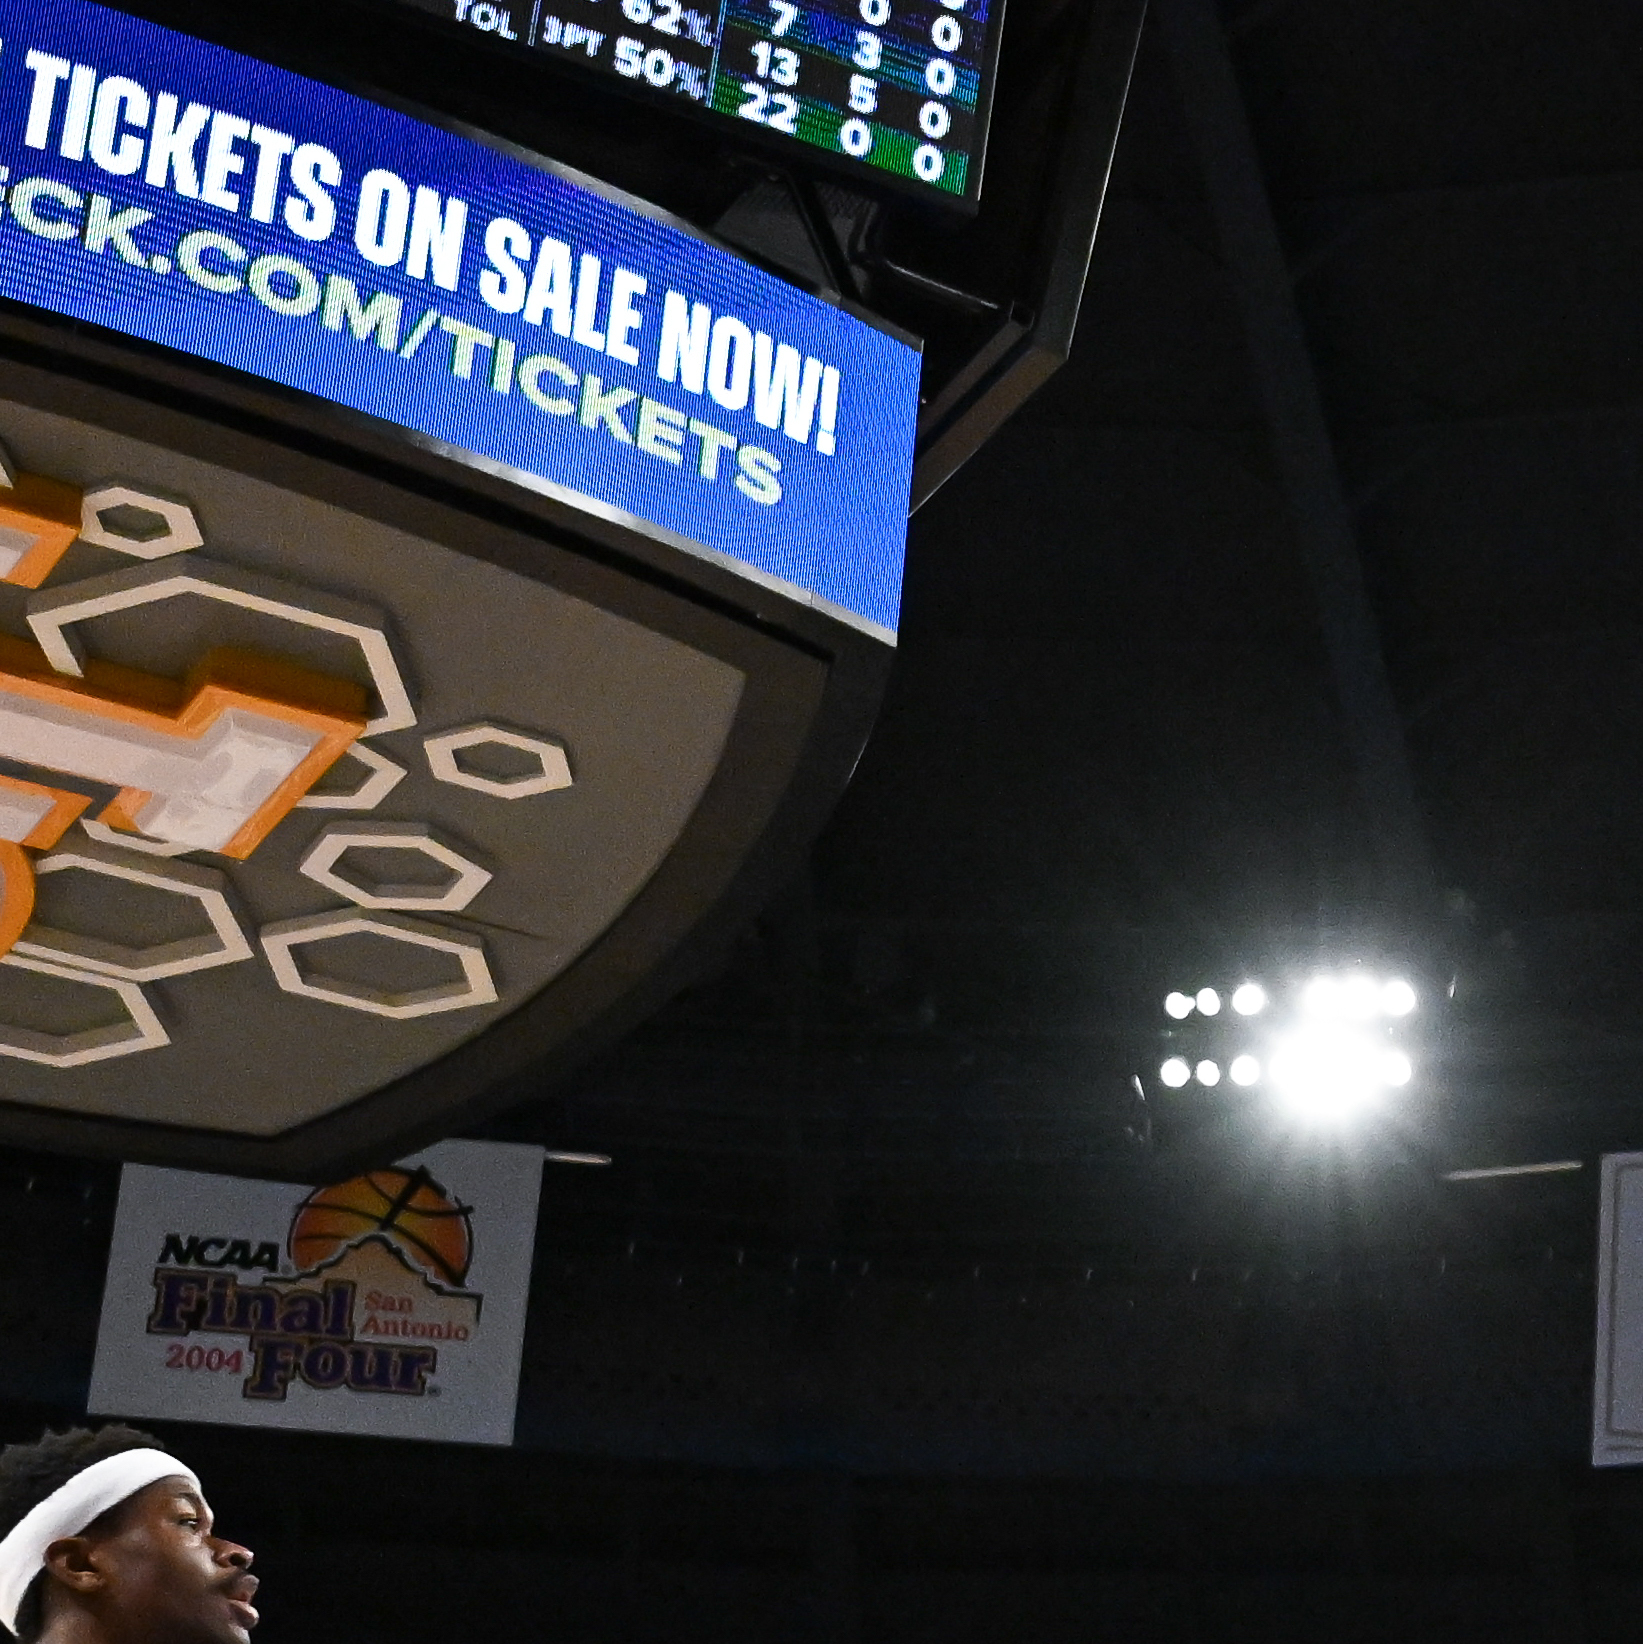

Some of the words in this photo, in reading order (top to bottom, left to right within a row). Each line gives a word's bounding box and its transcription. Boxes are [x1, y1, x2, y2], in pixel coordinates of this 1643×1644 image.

[854, 30, 882, 71] 3
[925, 57, 956, 96] 0
[931, 14, 963, 53] 0
[751, 40, 800, 86] 13
[848, 75, 879, 115] 5
[919, 100, 950, 140] 0
[738, 82, 801, 134] 22
[841, 117, 873, 159] 0
[913, 143, 944, 183] 0
[25, 47, 344, 243] TICKETS
[355, 169, 467, 292] ON
[479, 217, 650, 368] SALE
[656, 288, 843, 457] NOW!
[0, 165, 784, 508] CK.COM/TICKETS
[159, 1234, 280, 1274] NCAA
[146, 1267, 358, 1342] Final
[164, 1343, 244, 1374] 2004
[359, 1313, 470, 1342] Antonio
[242, 1334, 438, 1402] Four
